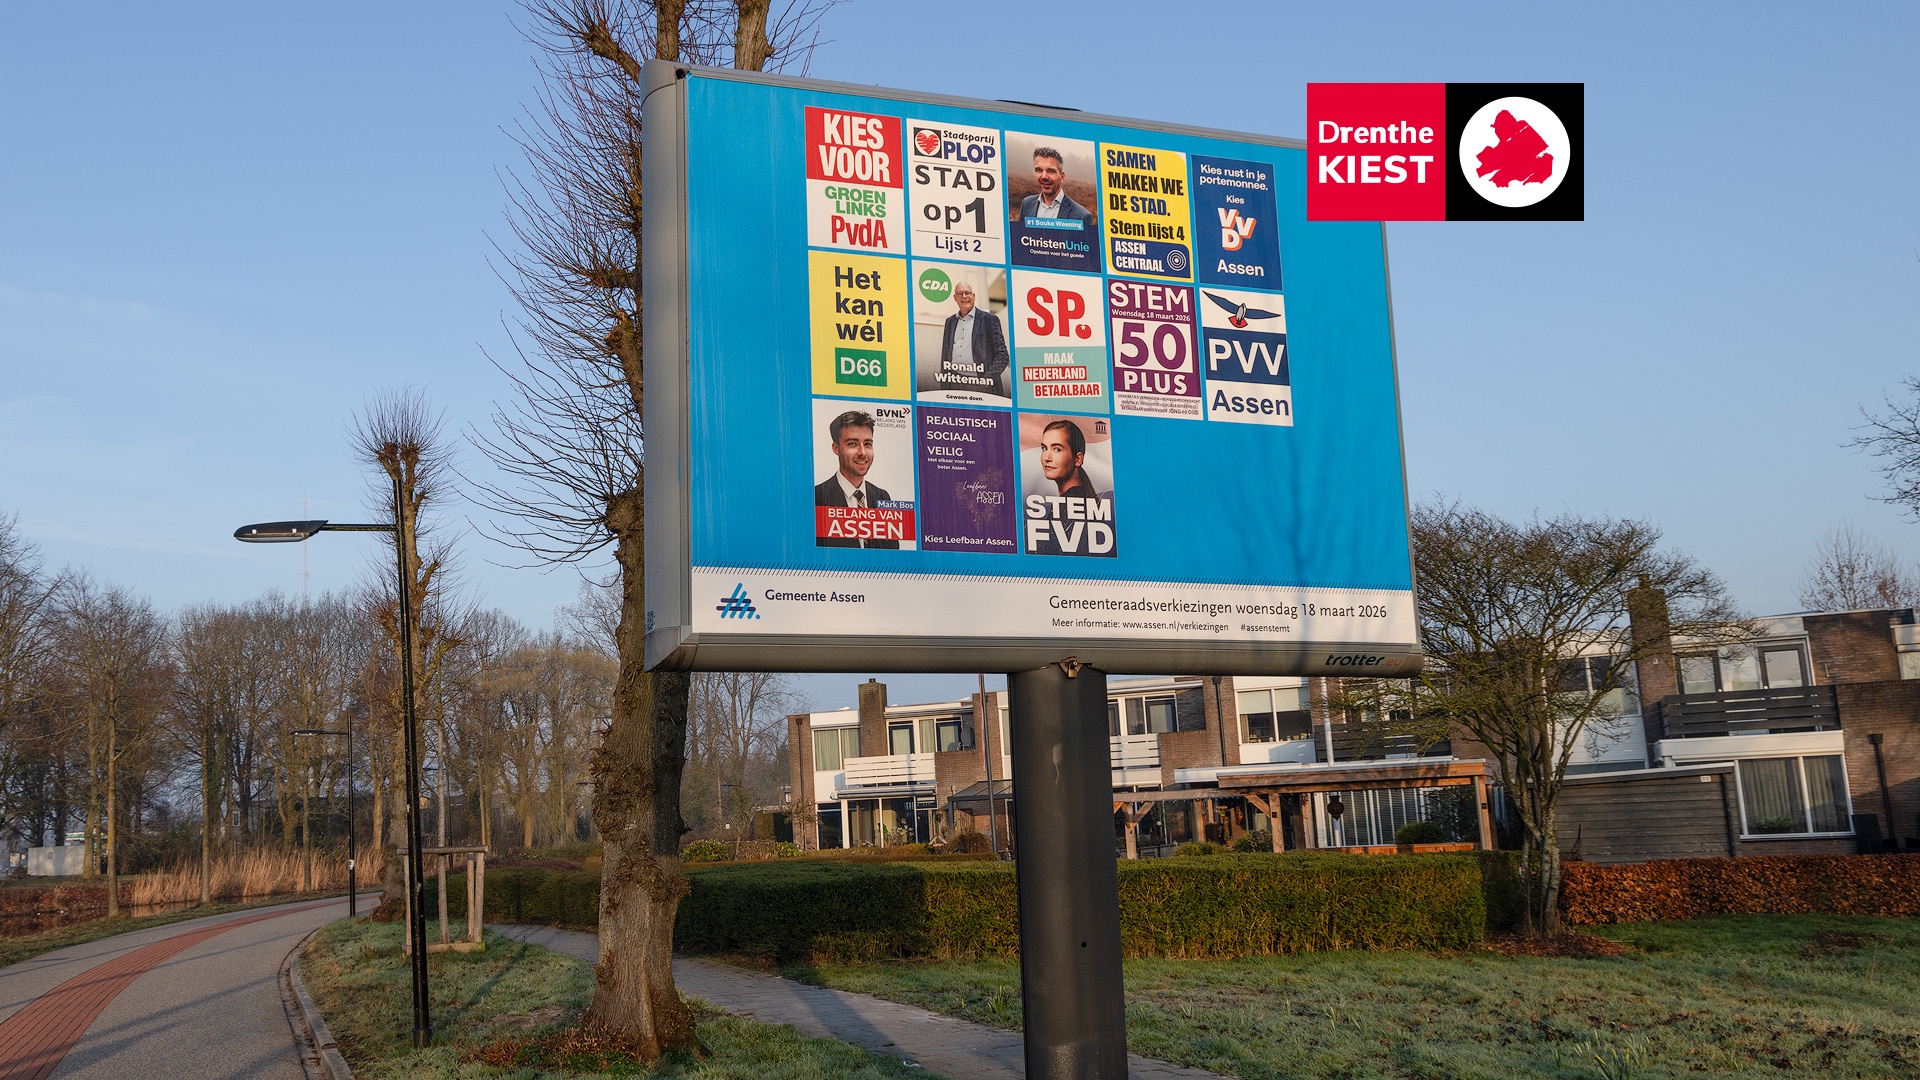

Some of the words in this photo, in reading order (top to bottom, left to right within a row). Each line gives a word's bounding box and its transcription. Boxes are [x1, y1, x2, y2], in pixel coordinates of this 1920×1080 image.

[824, 112, 884, 150] KIES
[943, 130, 994, 145] Stadspartij
[943, 141, 996, 164] PLOP
[1107, 149, 1156, 171] SAMEN
[819, 144, 890, 183] VOOR
[915, 165, 995, 192] STAD
[1201, 164, 1222, 175] Kies
[1224, 168, 1244, 178] rust
[1246, 169, 1255, 179] in
[1257, 171, 1266, 181] je
[1108, 172, 1158, 193] MAKEN
[1161, 177, 1184, 196] WE
[1200, 176, 1268, 191] portemonnee.
[825, 186, 886, 204] GROEN
[1226, 195, 1244, 204] Kies
[836, 200, 886, 218] LINKS
[1110, 193, 1127, 211] DE
[1130, 196, 1170, 217] STAD.
[831, 215, 888, 248] PvdA
[1056, 221, 1082, 229] Weening
[1110, 219, 1145, 237] Stem
[1148, 223, 1174, 240] lijst
[1177, 226, 1185, 240] 4
[936, 236, 968, 253] Lijst
[973, 240, 982, 252] 2
[1021, 236, 1089, 252] ChristenUnie
[1115, 240, 1146, 255] ASSEN
[1116, 256, 1164, 272] CENTRAAL
[1217, 259, 1264, 276] Assen
[835, 266, 881, 291] Het
[921, 280, 949, 292] CDA
[836, 292, 883, 317] kan
[1110, 283, 1188, 313] STEM
[1112, 309, 1145, 319] Woensdag
[1156, 313, 1174, 321] maart
[836, 319, 883, 342] wél
[1120, 322, 1186, 370] 50
[1044, 352, 1074, 364] MAAK
[1208, 338, 1285, 376] PVV
[840, 357, 881, 377] D66
[943, 361, 984, 373] Ronald
[1025, 368, 1086, 380] NEDERLAND
[934, 373, 994, 386] Witteman
[1124, 371, 1187, 395] PLUS
[1035, 384, 1100, 396] BETAALBAAR
[1212, 389, 1289, 416] Assen
[876, 409, 905, 418] BVNL
[926, 416, 996, 428] REALISTISCH
[926, 431, 976, 442] SOCIAAL
[927, 446, 963, 456] VEILIG
[828, 508, 875, 519] BELANG
[879, 511, 902, 520] VAN
[1026, 495, 1111, 521] STEM
[828, 520, 903, 539] ASSEN
[1027, 520, 1114, 554] FVD
[925, 535, 943, 543] Kies
[946, 536, 983, 545] Leefbaar
[986, 538, 1014, 546] Assen.
[765, 589, 826, 602] Gemeente
[830, 591, 865, 603] Assen
[1049, 595, 1232, 617] Gemeenteraadsverkiezingen
[1236, 602, 1298, 619] woensdag
[1302, 604, 1315, 616] 18
[1320, 605, 1355, 617] maart
[1358, 605, 1387, 618] 2026
[1052, 619, 1073, 628] Meer
[1076, 618, 1120, 628] informatie:
[1122, 620, 1229, 633] www.assen.nl/verkiezingen
[1240, 624, 1290, 633] #assenstemt
